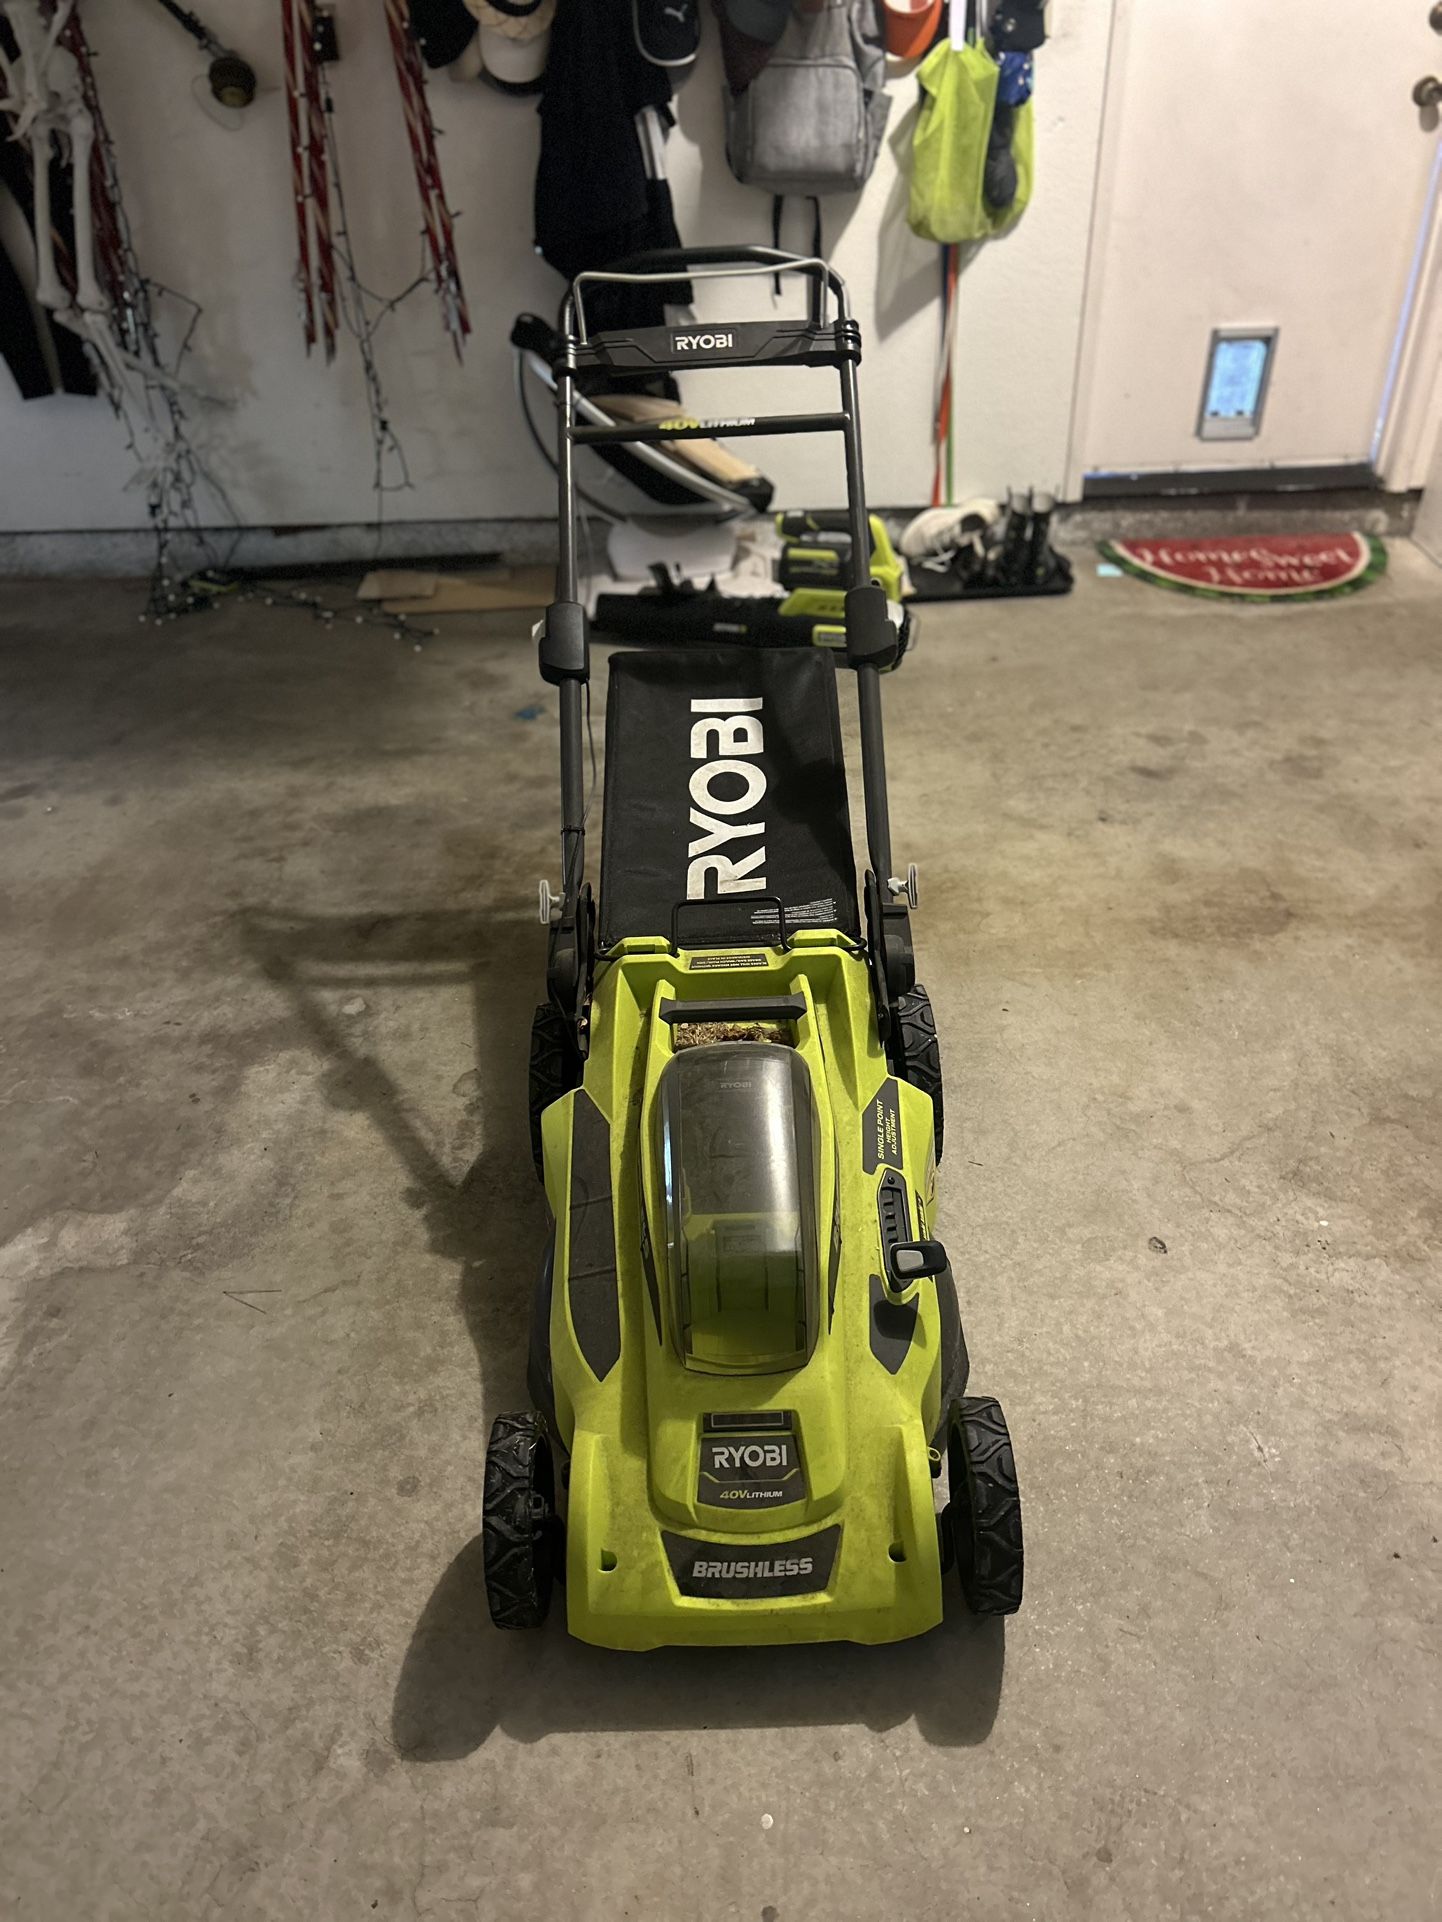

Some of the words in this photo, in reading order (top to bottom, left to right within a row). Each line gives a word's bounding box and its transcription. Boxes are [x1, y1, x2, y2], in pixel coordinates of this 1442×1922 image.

[675, 333, 733, 350] RYOBI
[687, 697, 767, 900] RYOBI
[720, 1081, 752, 1089] RYOBI
[876, 1099, 884, 1126] POINT
[877, 1126, 885, 1160] SINGLE
[711, 1445, 788, 1468] RYOBI
[692, 1557, 813, 1578] BRUSHLESS
